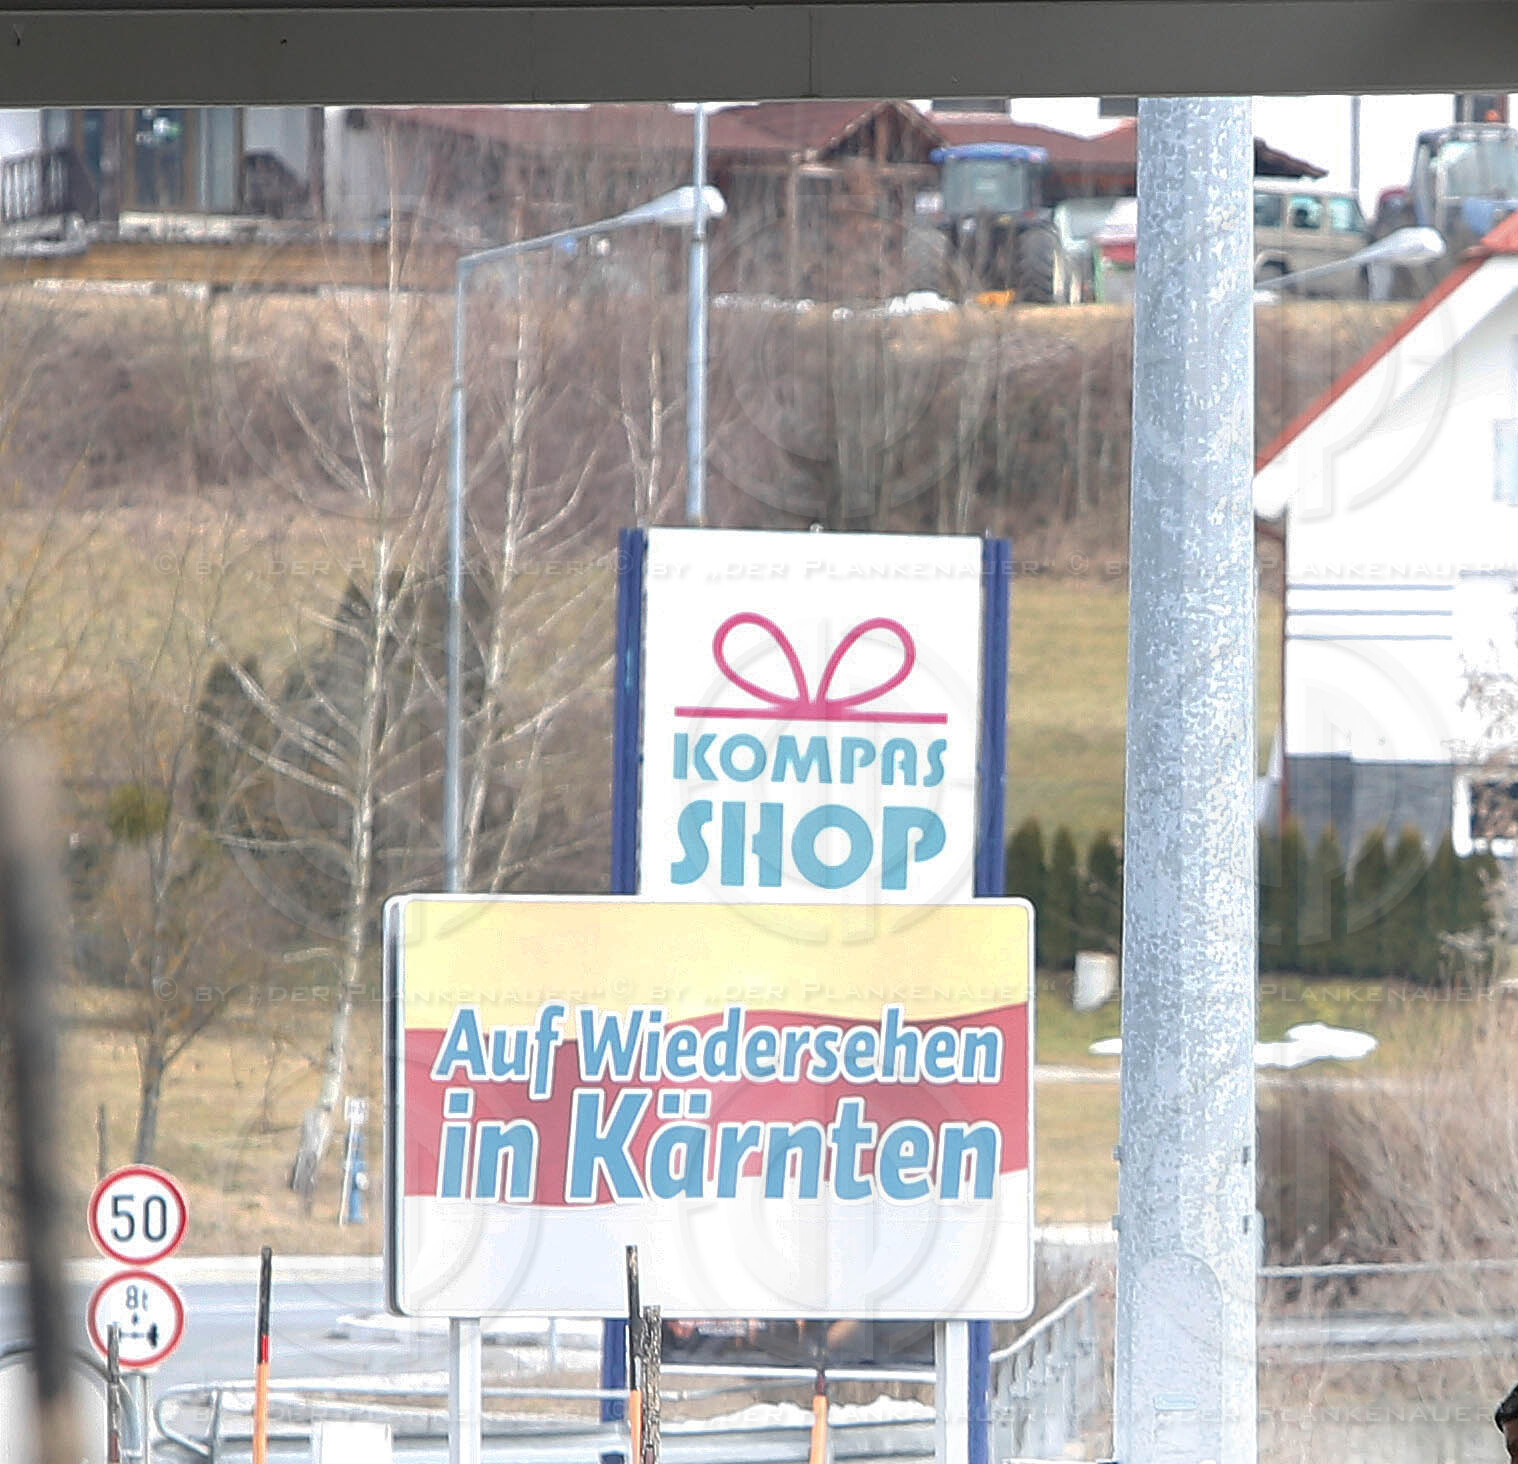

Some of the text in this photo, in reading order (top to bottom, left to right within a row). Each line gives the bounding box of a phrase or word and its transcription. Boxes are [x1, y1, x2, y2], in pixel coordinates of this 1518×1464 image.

[672, 732, 948, 788] KOMPAS
[670, 799, 947, 890] SHOP
[434, 1004, 1003, 1098] Auf Wiedersehen
[437, 1089, 1003, 1203] in Kärnten
[111, 1194, 168, 1243] 50
